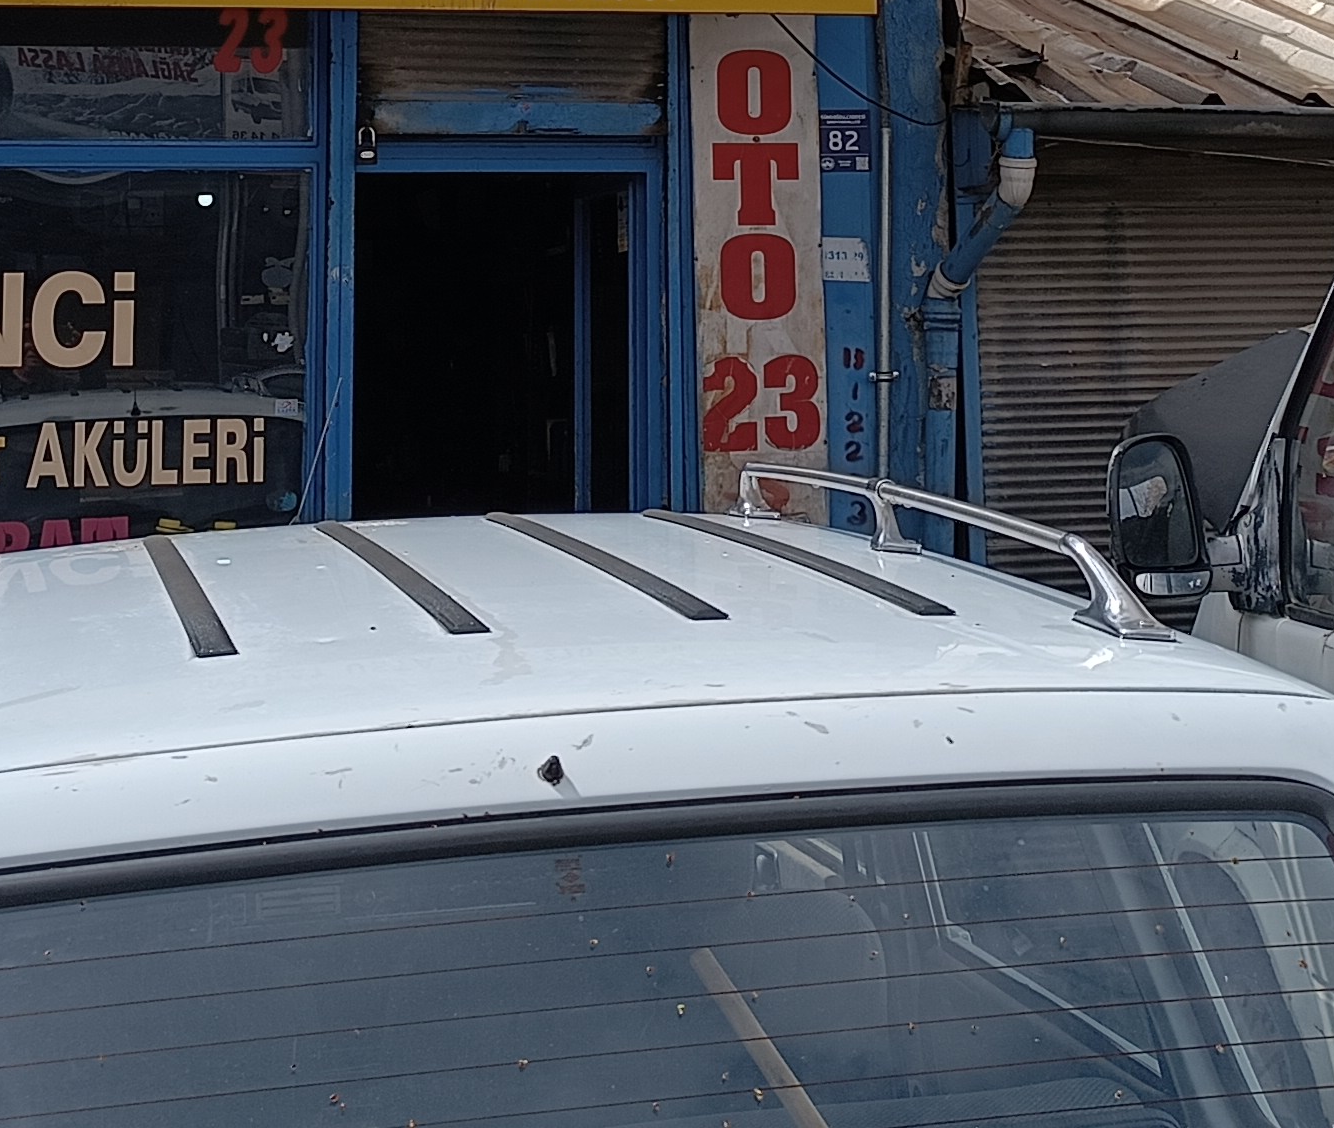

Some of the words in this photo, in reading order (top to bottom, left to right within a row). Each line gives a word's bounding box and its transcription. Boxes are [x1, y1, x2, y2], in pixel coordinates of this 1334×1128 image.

[213, 8, 290, 74] 23
[828, 130, 860, 151] 82
[711, 49, 800, 320] OTO
[703, 354, 821, 452] 23
